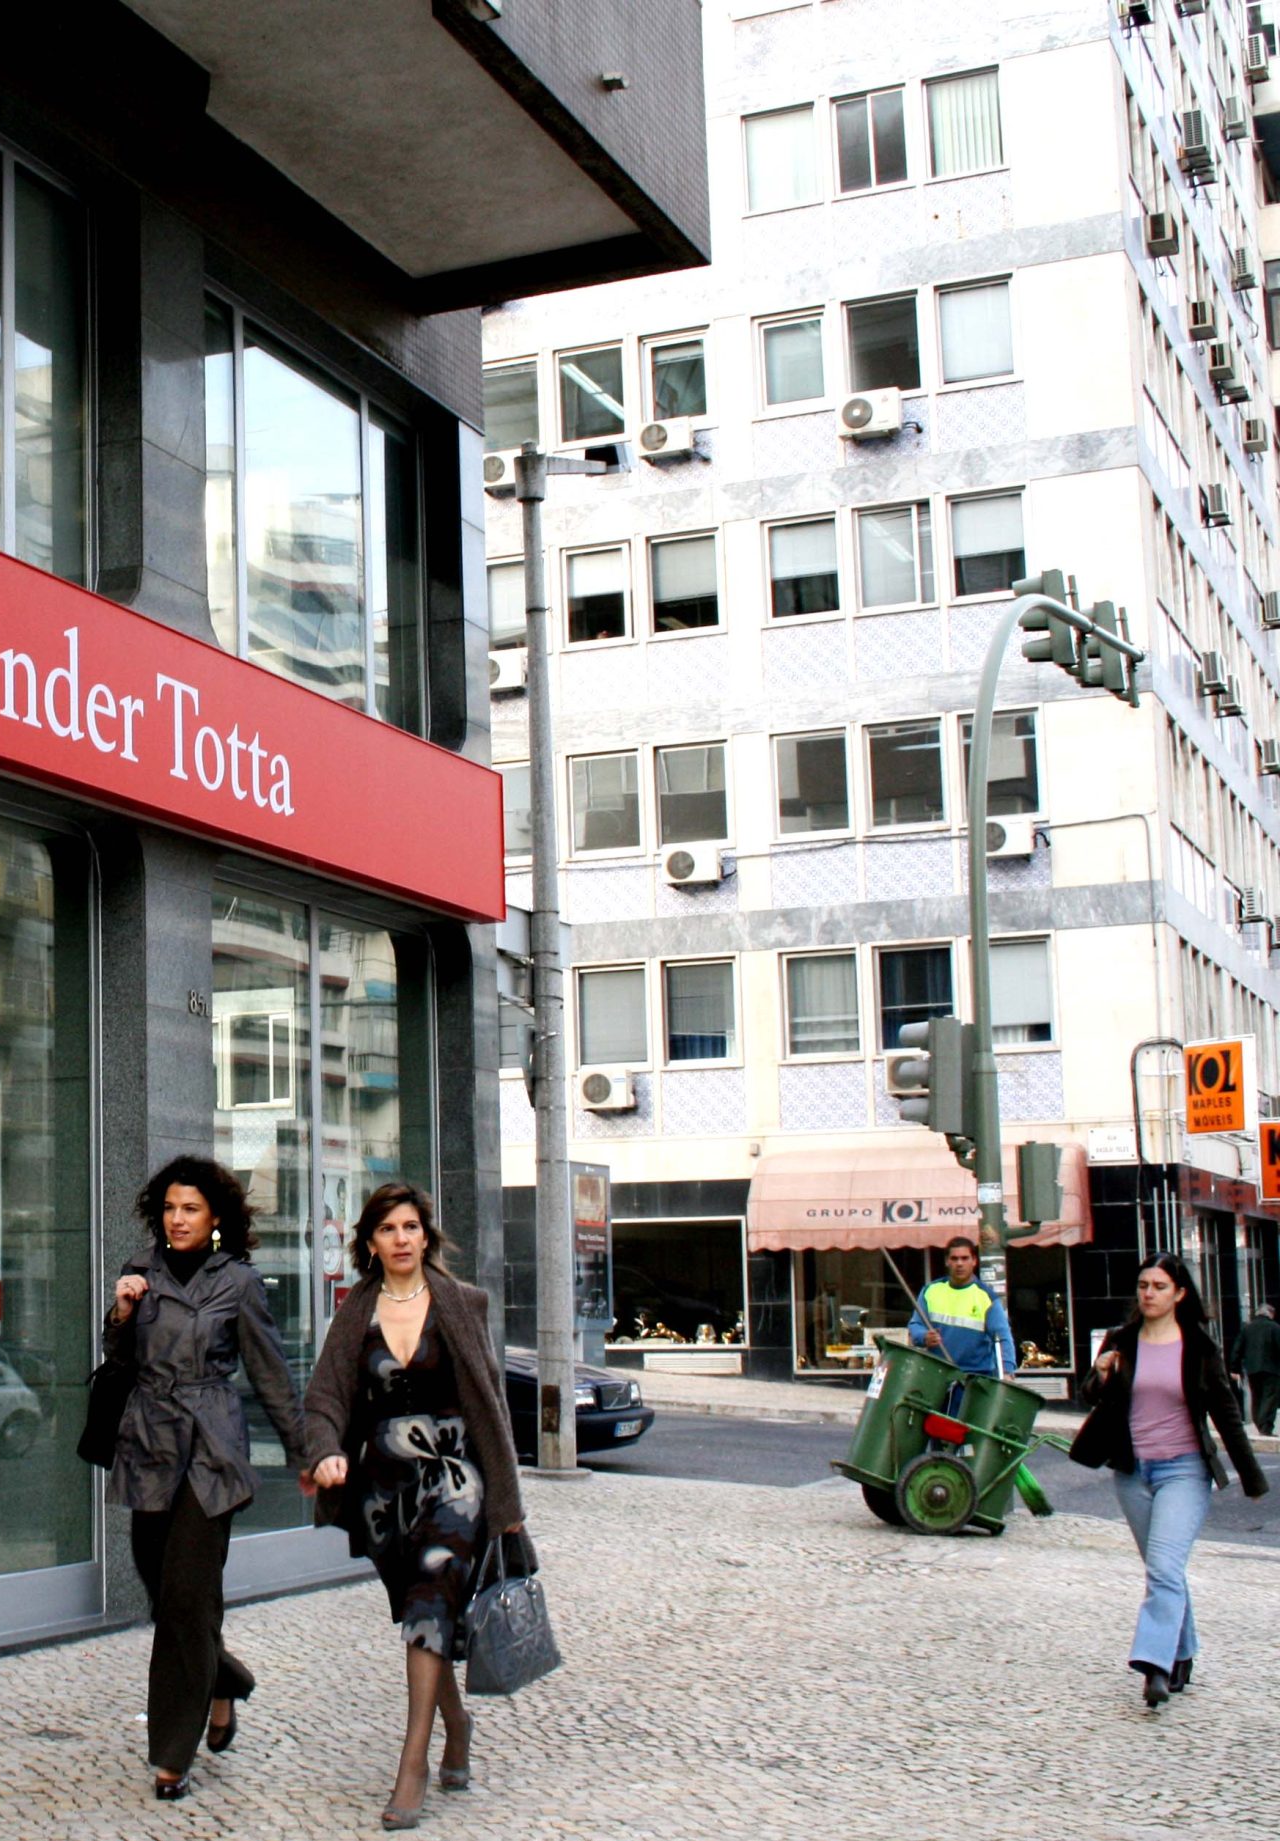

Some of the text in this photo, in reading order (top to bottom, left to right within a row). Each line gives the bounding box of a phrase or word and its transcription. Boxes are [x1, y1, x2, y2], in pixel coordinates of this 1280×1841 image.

[156, 672, 295, 816] Totta
[1188, 1049, 1236, 1095] KOL
[1192, 1096, 1232, 1110] MAPLES
[806, 1200, 1008, 1223] GRUPO KOL MOVS
